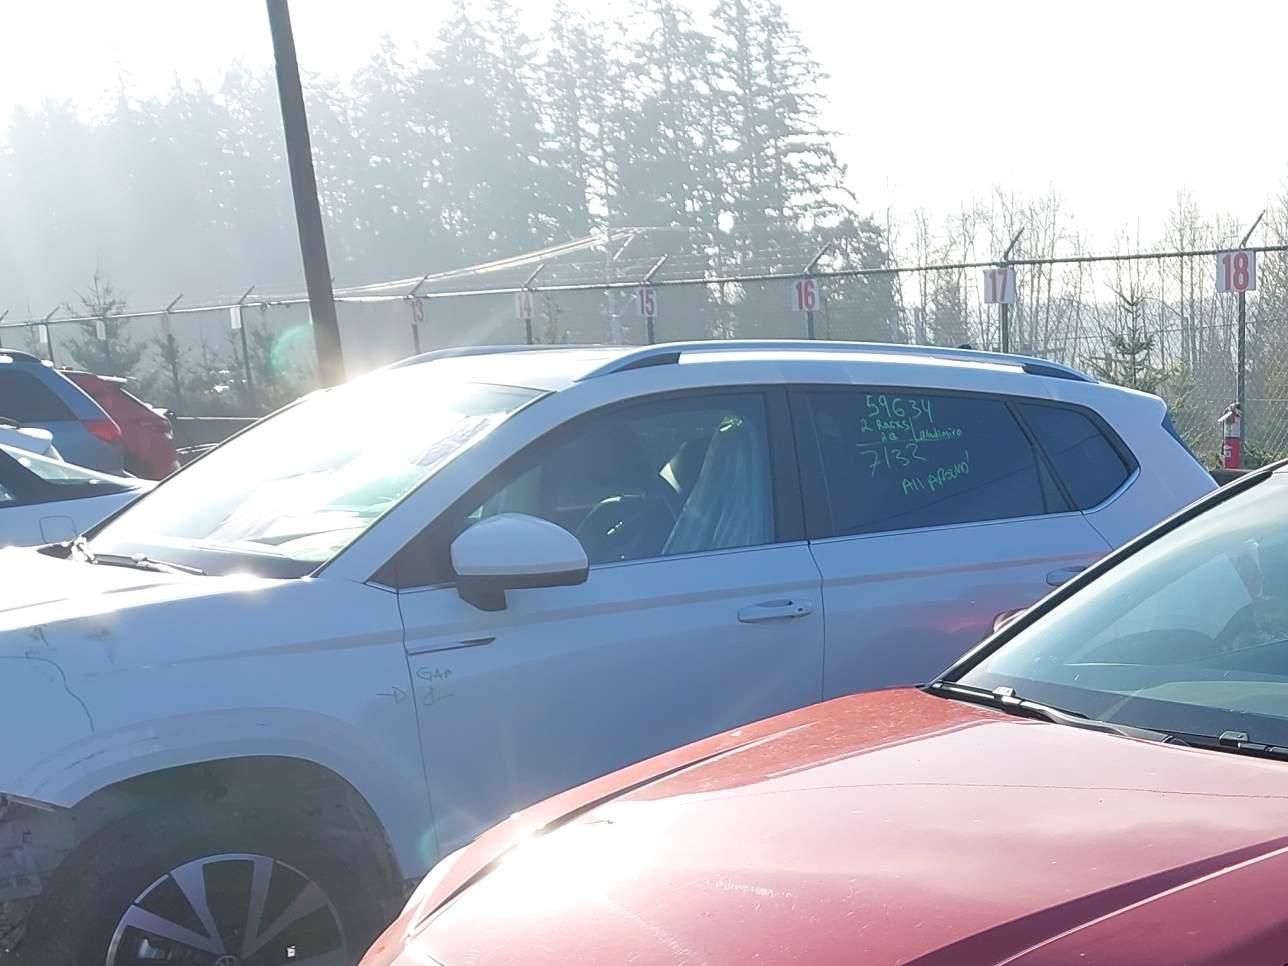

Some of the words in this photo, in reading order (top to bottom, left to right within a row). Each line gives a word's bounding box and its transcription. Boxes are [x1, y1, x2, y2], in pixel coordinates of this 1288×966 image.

[989, 269, 1009, 303] 17
[1222, 252, 1249, 291] 18
[640, 287, 655, 317] 15
[795, 279, 816, 310] 16
[865, 394, 934, 423] 59634
[860, 443, 928, 478] 7132
